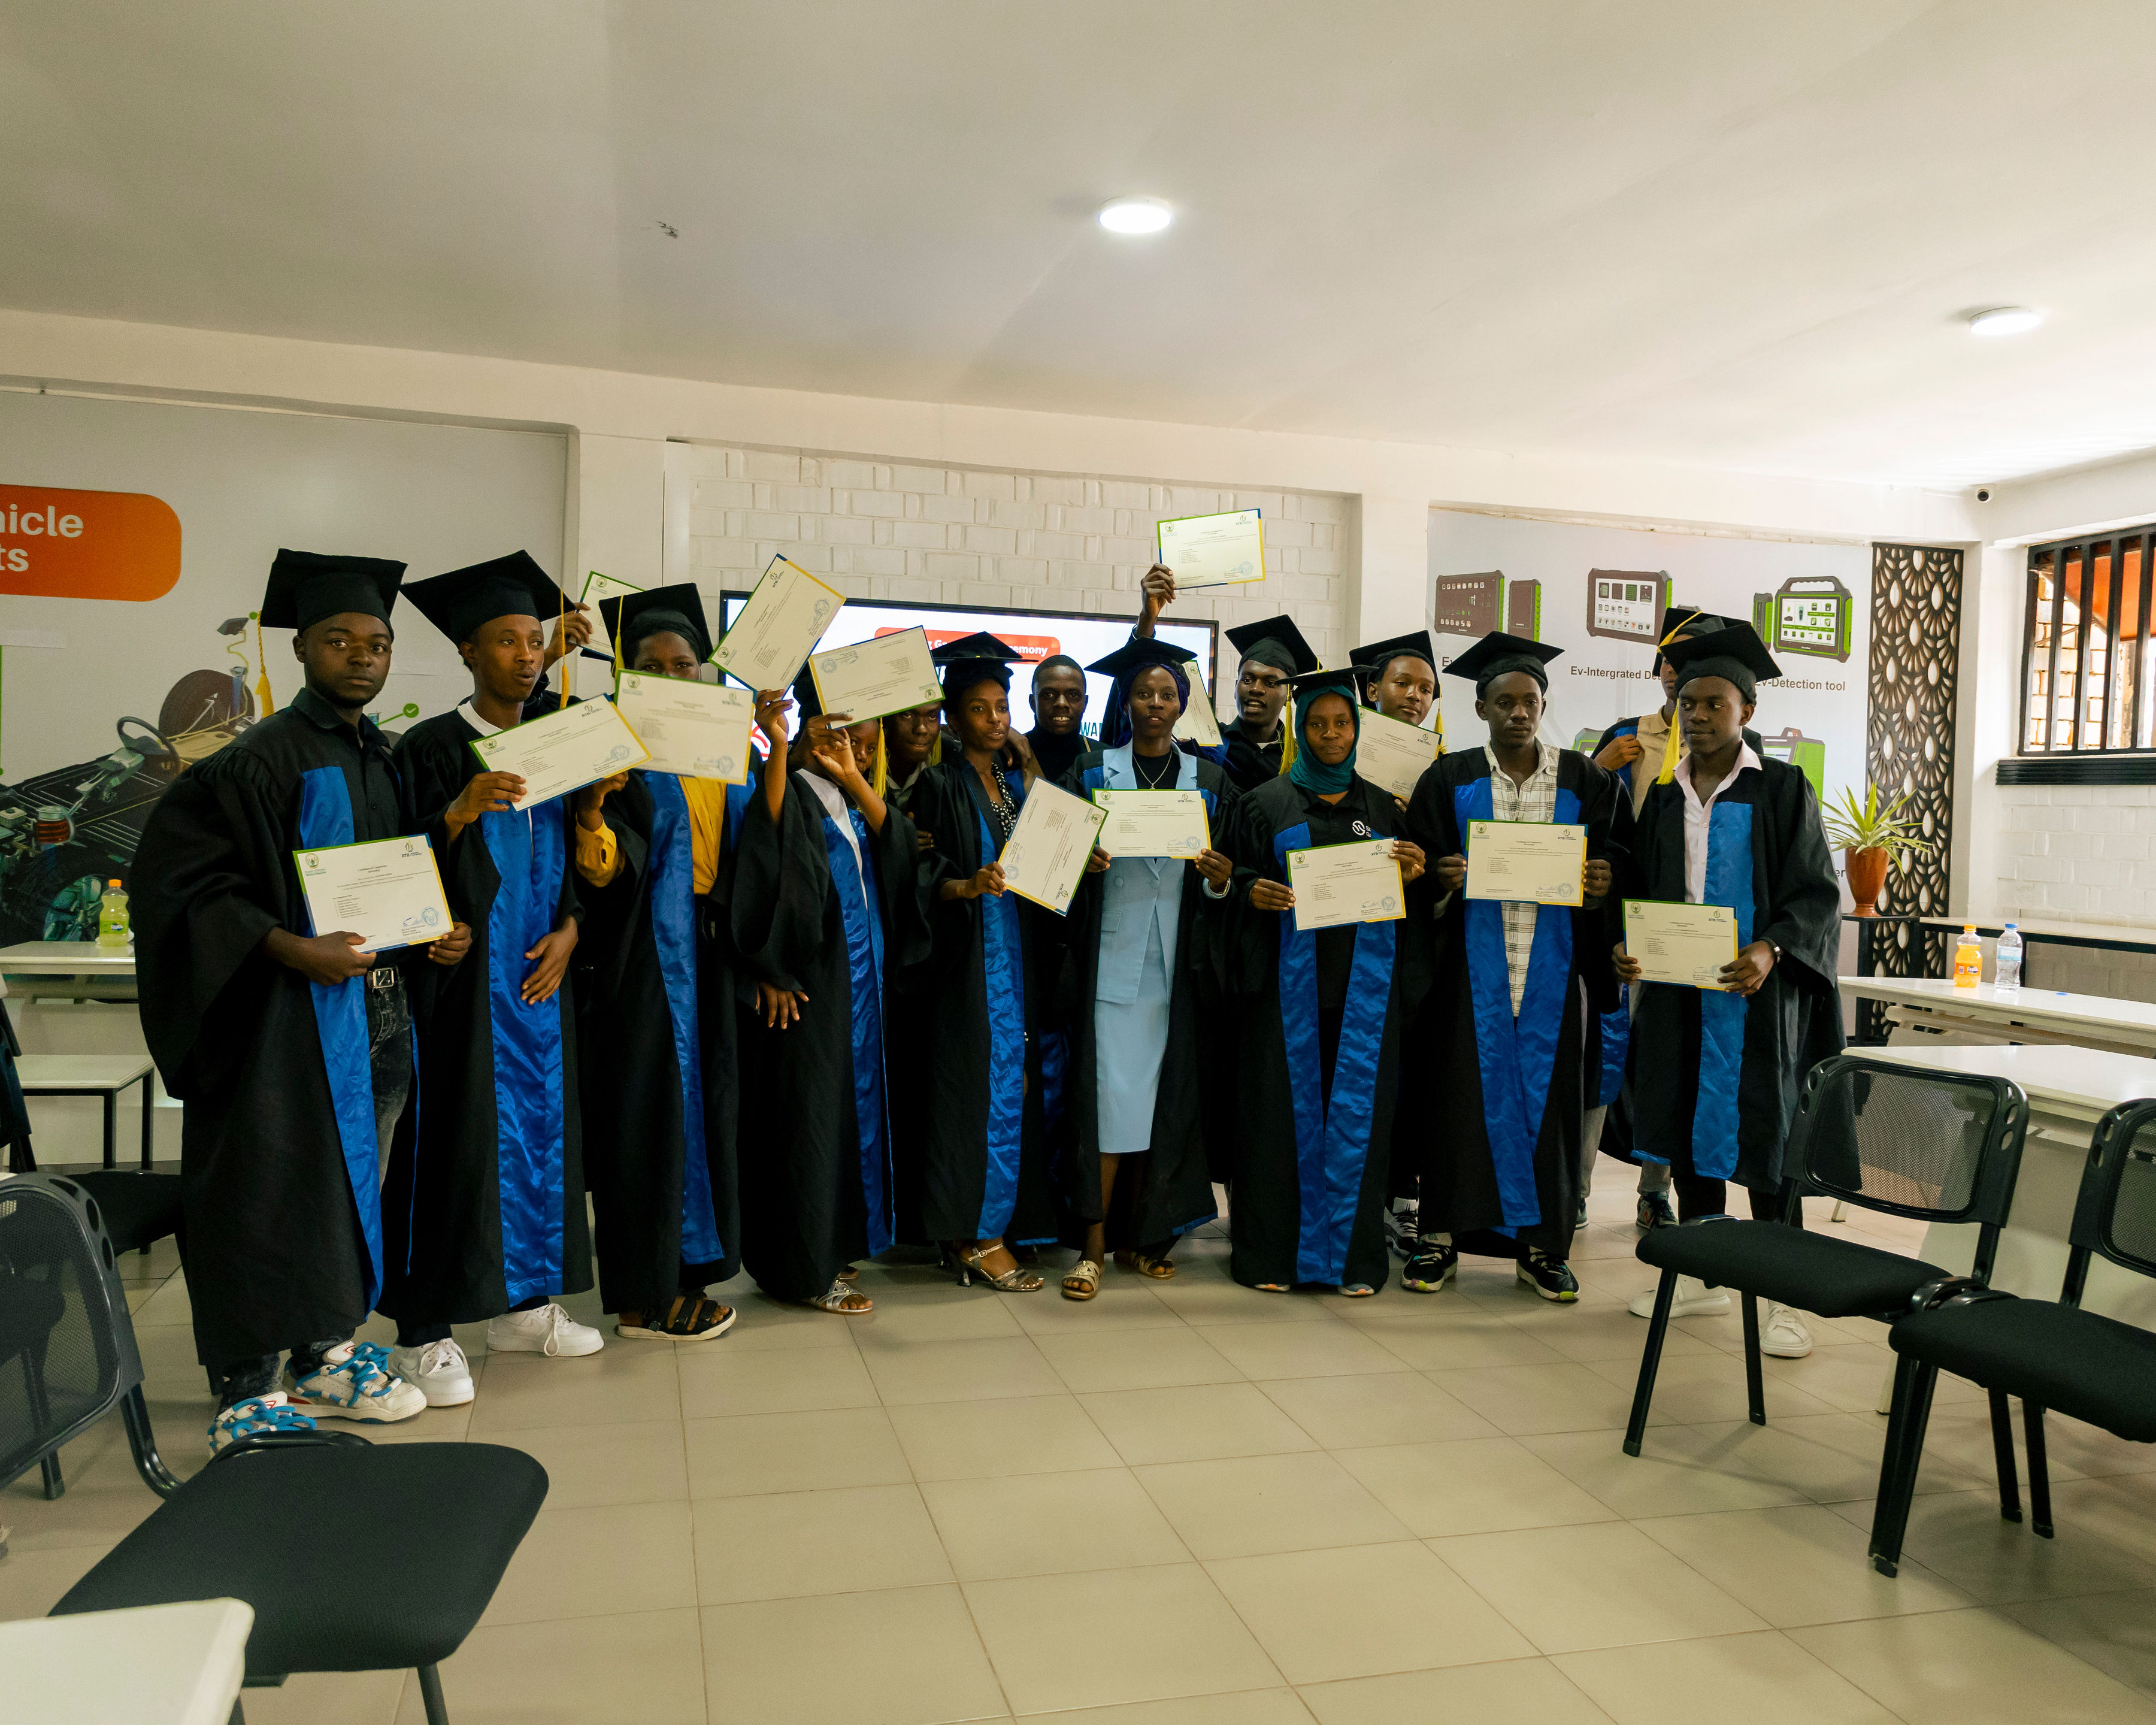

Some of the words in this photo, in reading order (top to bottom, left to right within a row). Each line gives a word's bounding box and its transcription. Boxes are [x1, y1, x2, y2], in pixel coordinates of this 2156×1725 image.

[0, 503, 84, 538] icle
[1009, 646, 1049, 658] emony
[1570, 665, 1642, 680] Ev-Intergrated
[1755, 677, 1822, 690] v-Detection
[1825, 680, 1846, 691] tool
